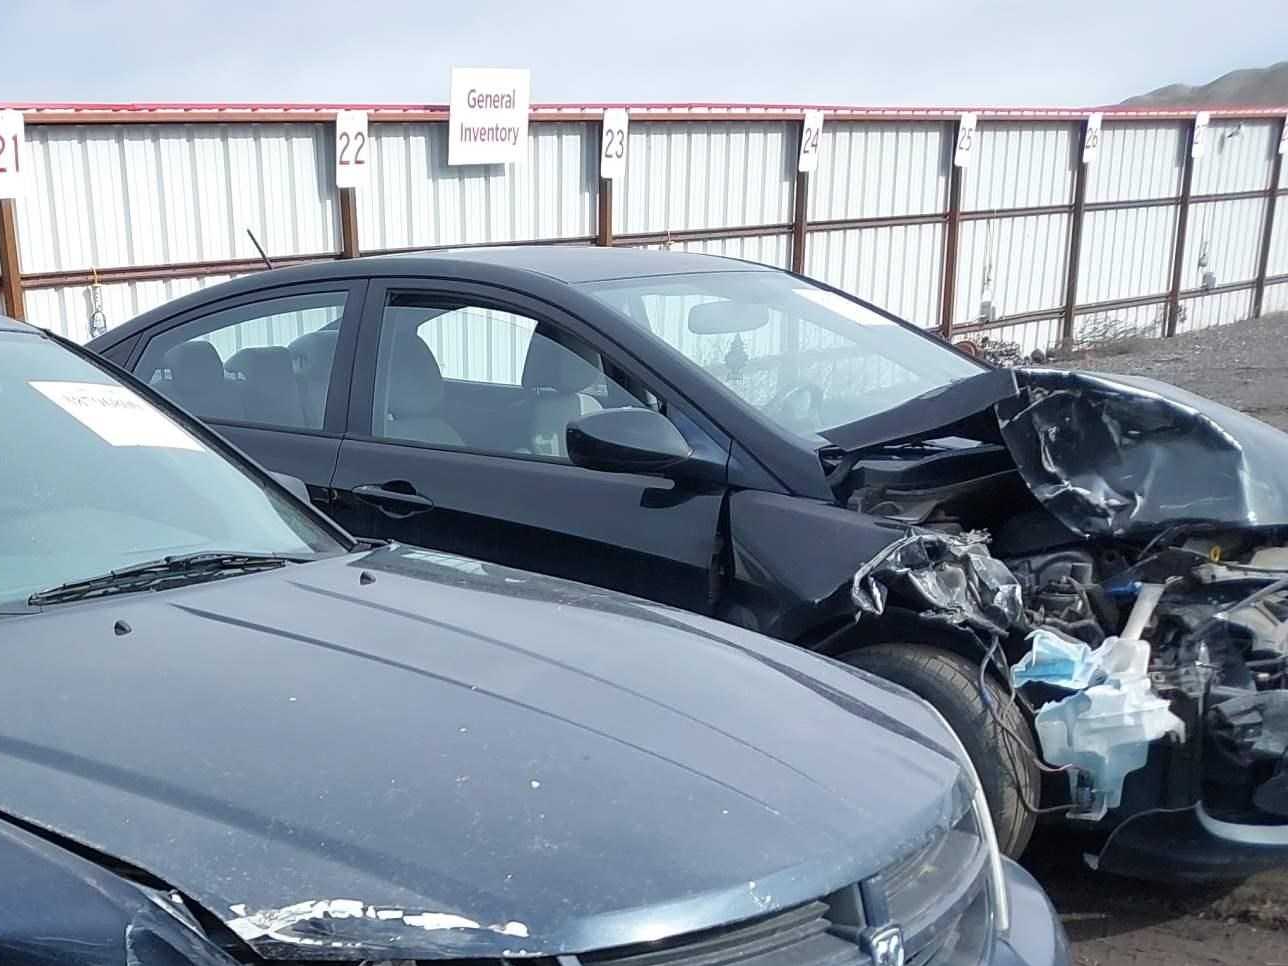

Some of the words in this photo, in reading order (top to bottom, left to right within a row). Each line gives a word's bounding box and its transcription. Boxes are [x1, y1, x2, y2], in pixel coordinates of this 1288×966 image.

[467, 89, 516, 109] General
[460, 122, 520, 146] Inventory
[604, 128, 625, 160] 23
[802, 127, 819, 156] 24
[959, 127, 973, 152] 25
[338, 131, 368, 166] 22
